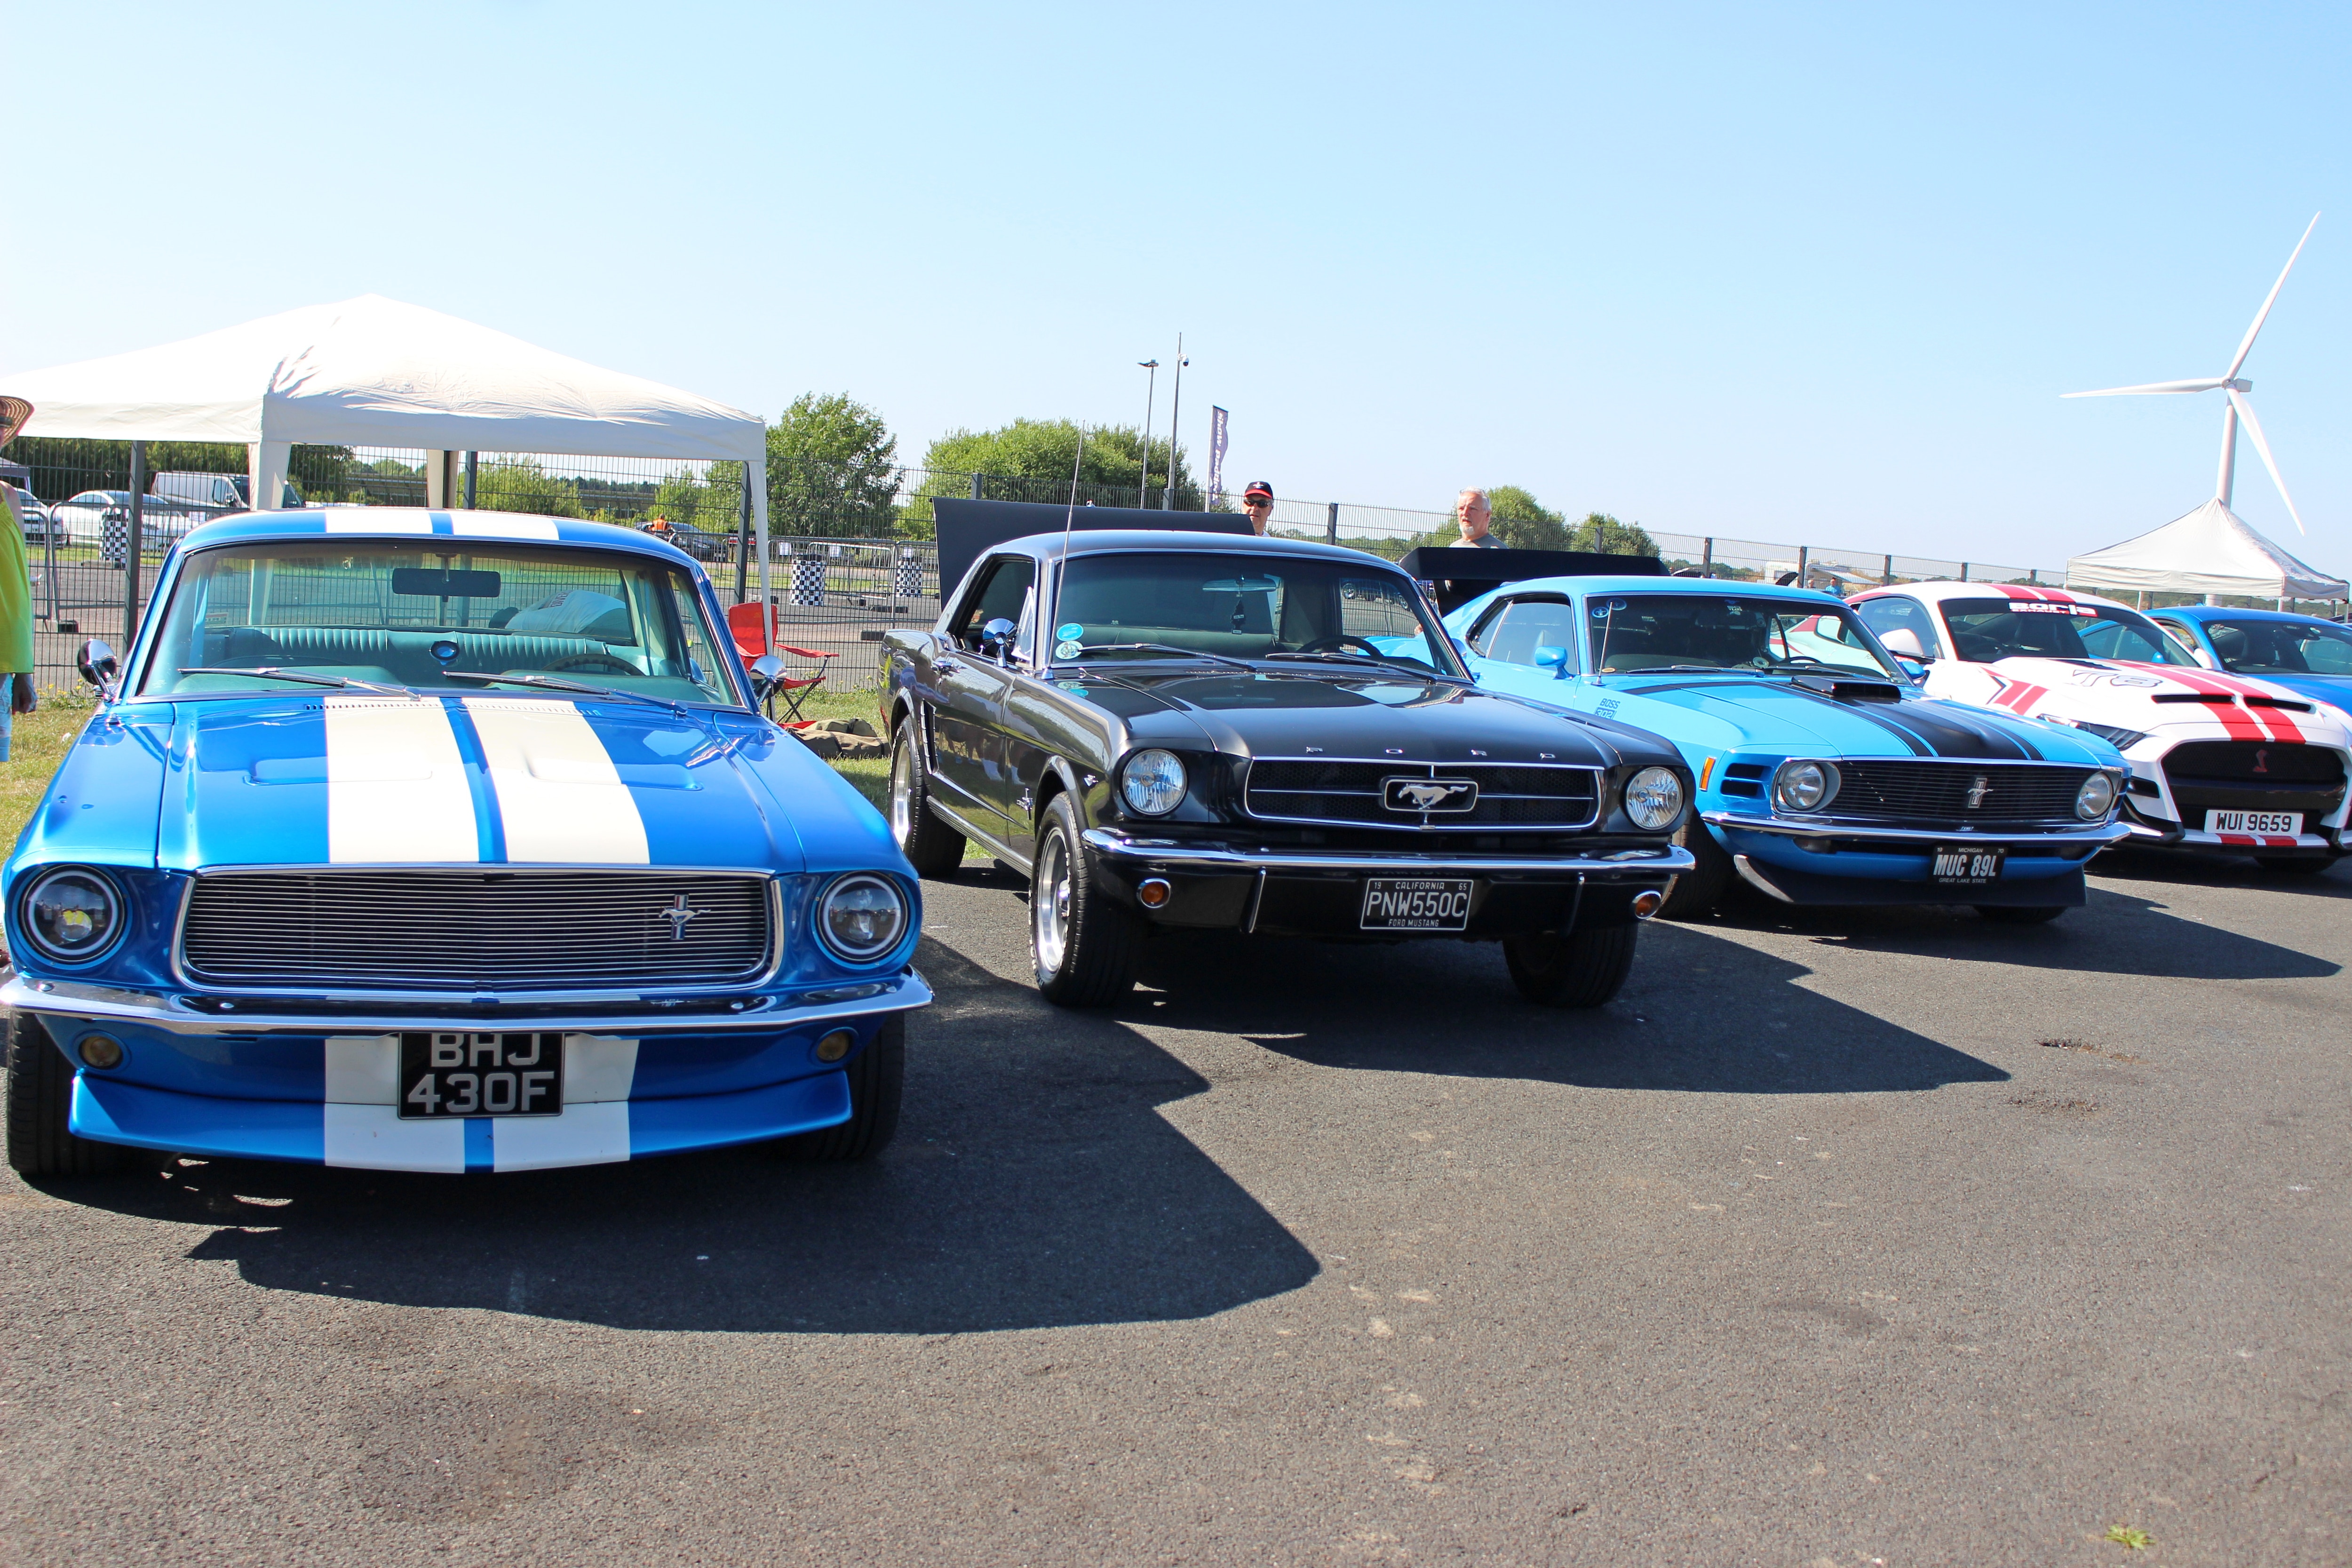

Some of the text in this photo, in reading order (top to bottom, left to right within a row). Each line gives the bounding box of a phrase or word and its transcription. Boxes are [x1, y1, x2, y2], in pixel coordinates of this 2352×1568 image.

[1595, 709, 1613, 719] 302
[1599, 698, 1621, 709] BOSS
[2216, 812, 2292, 832] WUI 9659
[1933, 854, 1997, 877] MUC 89L
[1367, 892, 1467, 917] PNW550C
[430, 1033, 541, 1067] BHJ
[408, 1070, 555, 1114] 430F
